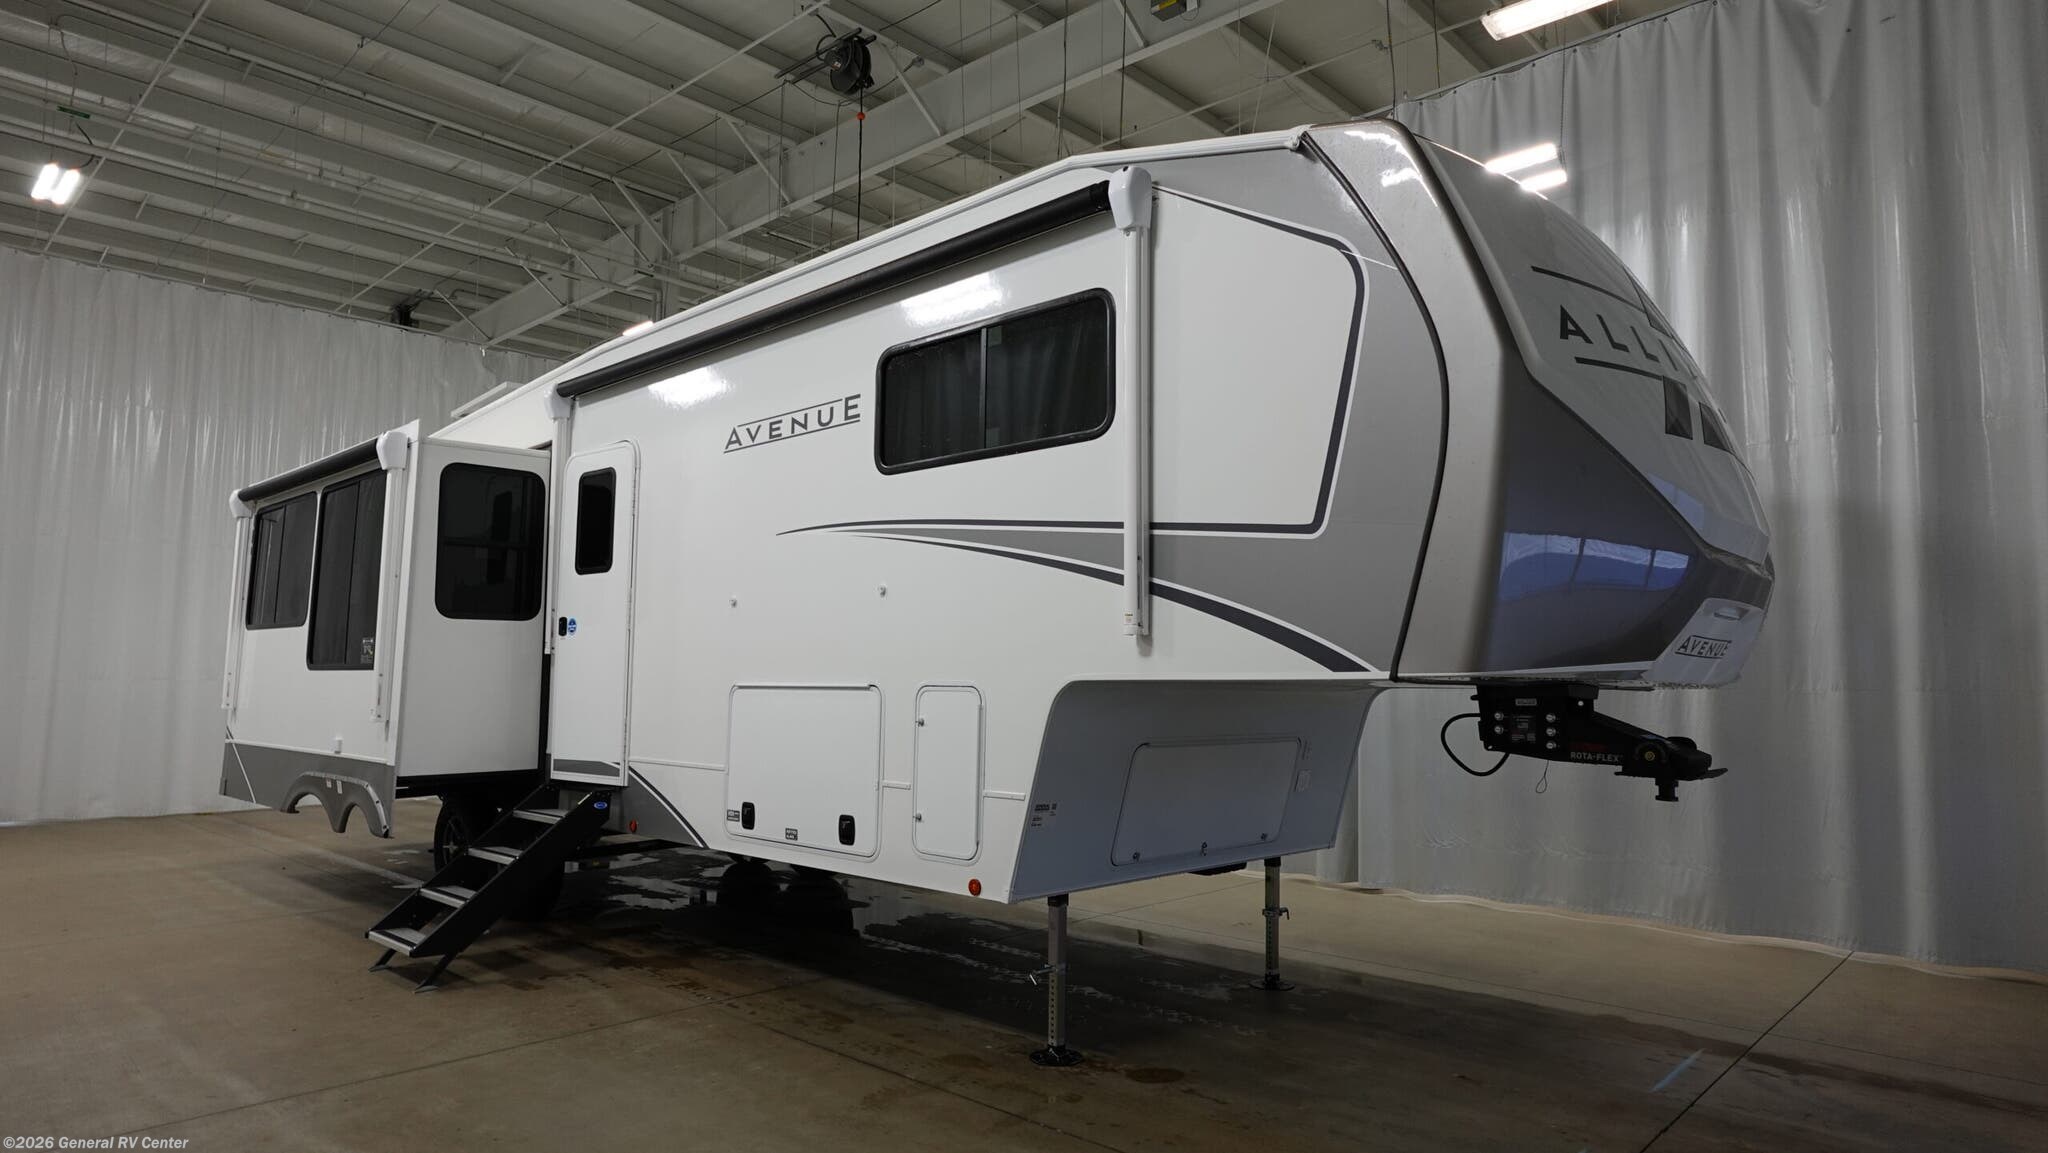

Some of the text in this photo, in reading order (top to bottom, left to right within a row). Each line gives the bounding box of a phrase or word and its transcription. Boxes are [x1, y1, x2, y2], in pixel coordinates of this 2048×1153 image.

[1559, 304, 1697, 380] ALLI
[725, 393, 862, 451] AVENUE
[1677, 635, 1729, 657] AVENUE
